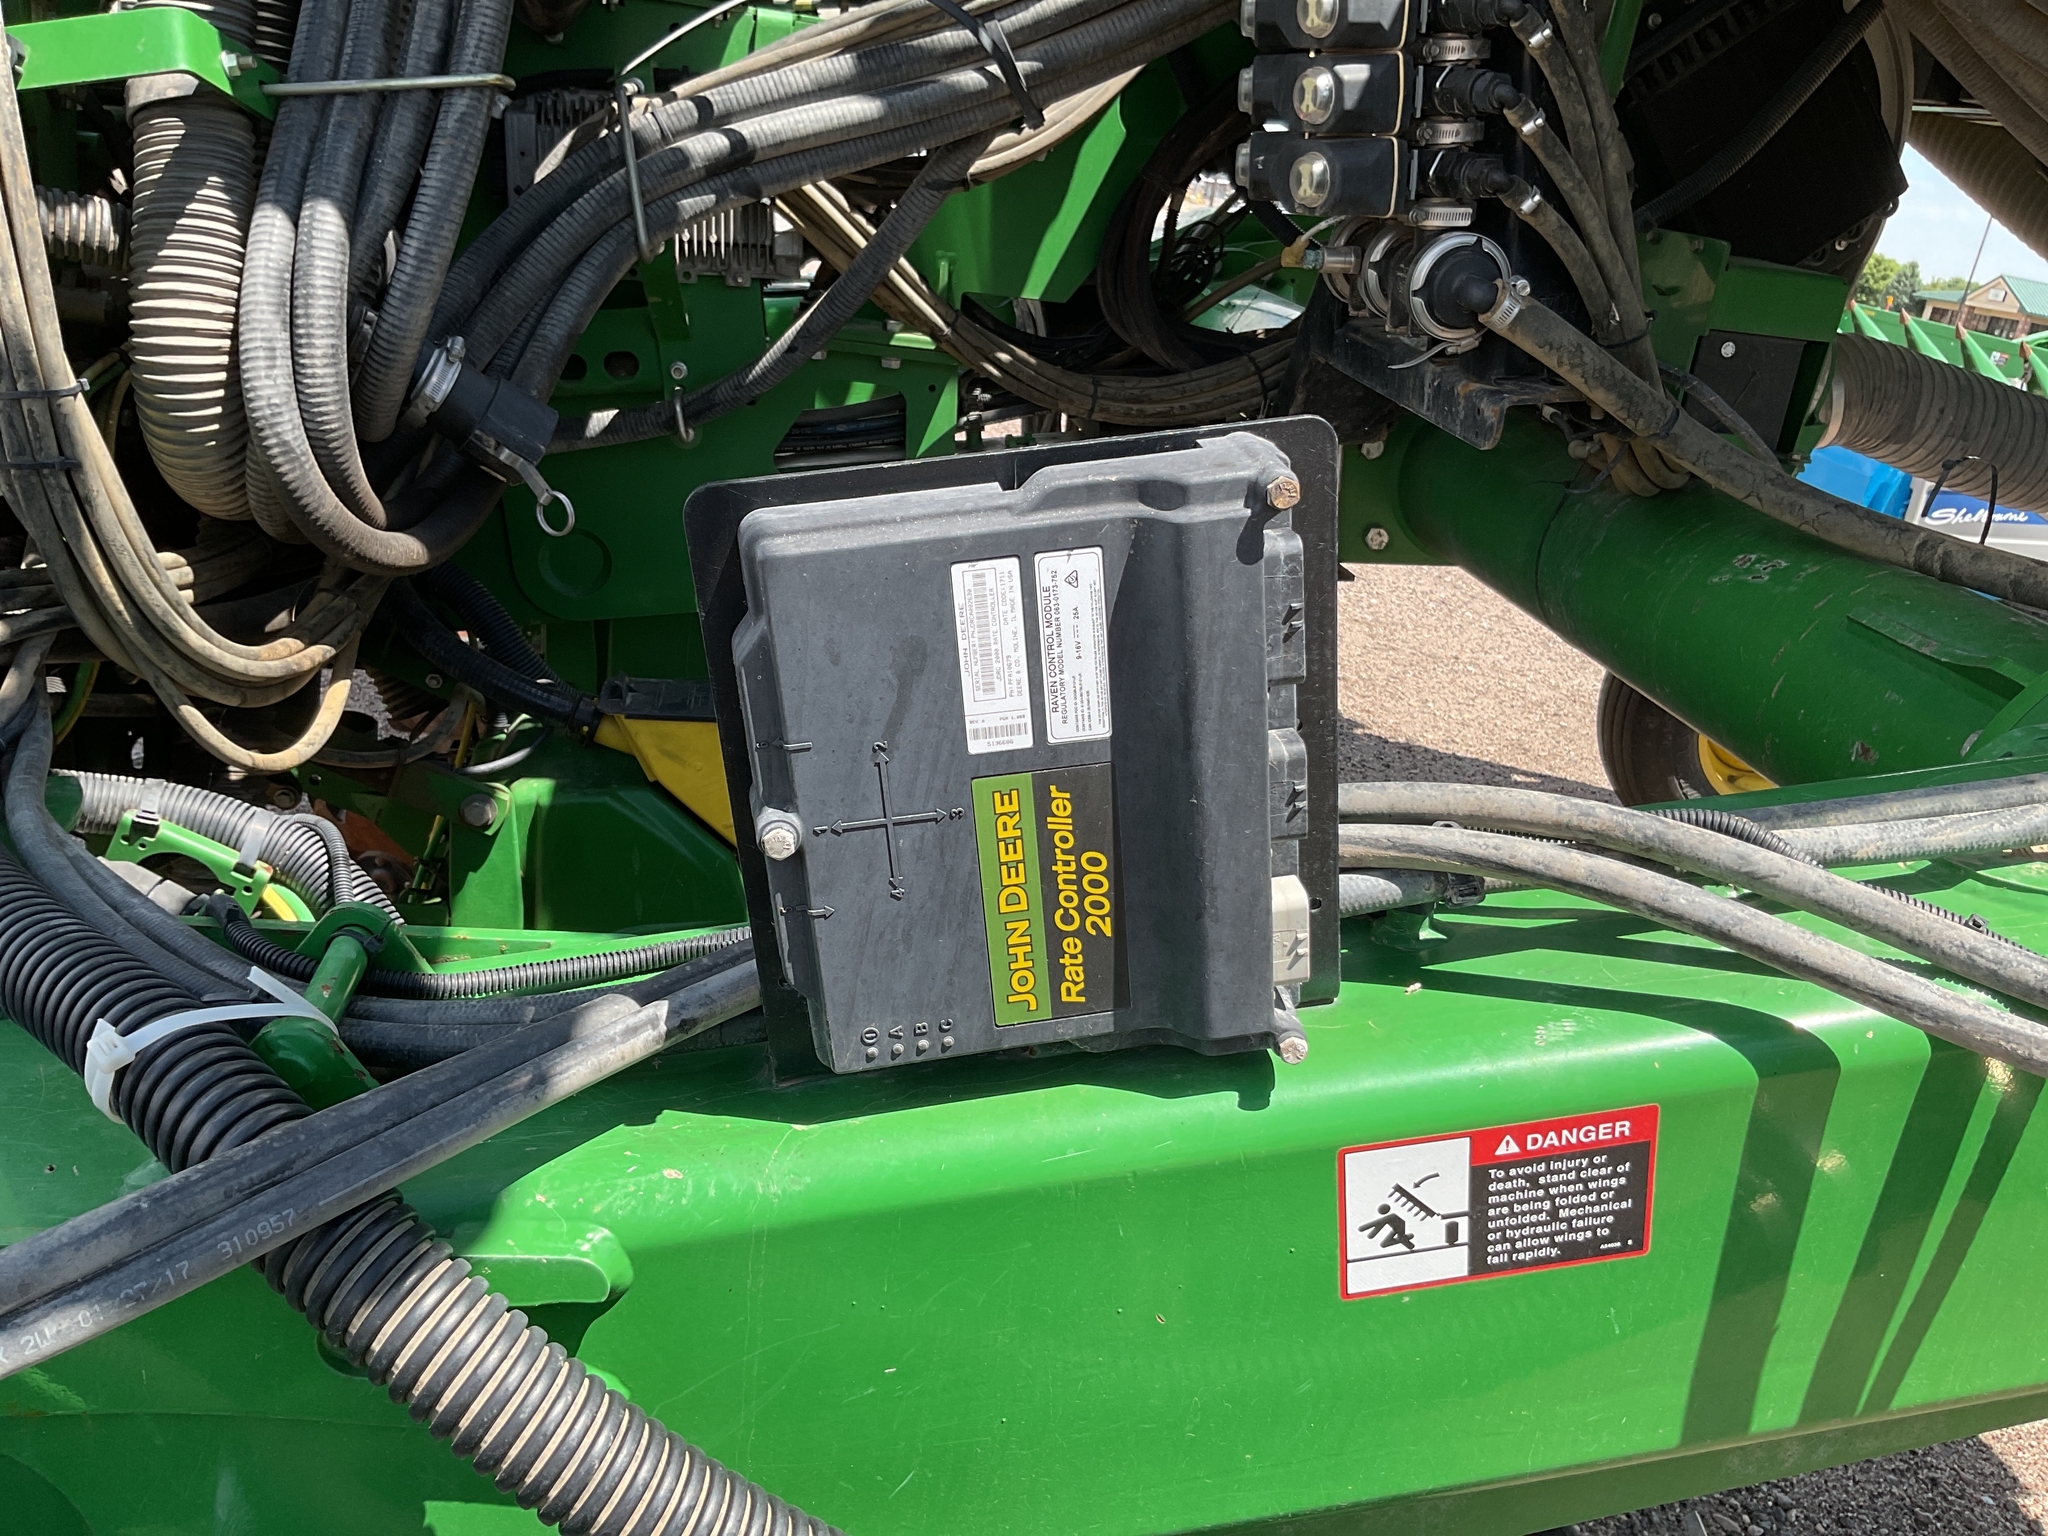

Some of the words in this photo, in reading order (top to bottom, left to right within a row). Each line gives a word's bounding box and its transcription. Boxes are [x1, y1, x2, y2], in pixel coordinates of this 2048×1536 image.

[988, 587, 998, 627] CONTROLLER
[1042, 586, 1053, 629] MODULE
[1050, 570, 1060, 615] 063-0173-752
[958, 604, 967, 641] DEERE
[1072, 606, 1080, 620] 25A
[1054, 616, 1063, 648] NUMBER
[962, 647, 971, 677] JOHN
[1046, 631, 1057, 678] CONTROL
[1056, 649, 1065, 675] MODEL
[1074, 640, 1083, 660] 9-16V
[1015, 677, 1023, 697] DEERE
[1049, 680, 1060, 713] RAVEN
[1058, 677, 1068, 724] REGULATORY
[993, 789, 1028, 914] DEERE
[1046, 784, 1080, 931] Controller
[1081, 851, 1111, 936] 2000
[1006, 919, 1037, 1011] JOHN
[1060, 936, 1085, 1003] Rate
[889, 1025, 904, 1037] A
[915, 1022, 928, 1034] B
[940, 1018, 954, 1030] C
[1527, 1121, 1630, 1150] DANGER
[1488, 1169, 1505, 1179] To
[1509, 1162, 1546, 1176] avoid
[1550, 1158, 1589, 1171] injury
[1592, 1154, 1607, 1164] or
[1488, 1178, 1530, 1192] death,
[1538, 1170, 1576, 1184] stand
[1580, 1166, 1613, 1178] clear
[1616, 1161, 1630, 1173] of
[1487, 1206, 1509, 1217] are
[1513, 1200, 1551, 1213] being
[1555, 1192, 1597, 1206] folded
[1600, 1190, 1615, 1200] or
[1488, 1189, 1544, 1204] machine
[1548, 1183, 1584, 1195] when
[1588, 1177, 1626, 1189] wings
[1487, 1231, 1502, 1241] or
[1506, 1221, 1567, 1239] hydraulic
[1572, 1215, 1614, 1228] failure
[1488, 1212, 1550, 1228] unfolded.
[1559, 1199, 1632, 1218] Mechanical
[217, 1207, 297, 1261] 310957
[1487, 1242, 1511, 1253] can
[1515, 1237, 1550, 1249] allow
[1554, 1230, 1592, 1243] wings
[1596, 1227, 1610, 1237] to
[1488, 1253, 1508, 1264] fall
[1512, 1247, 1561, 1261] rapidly.
